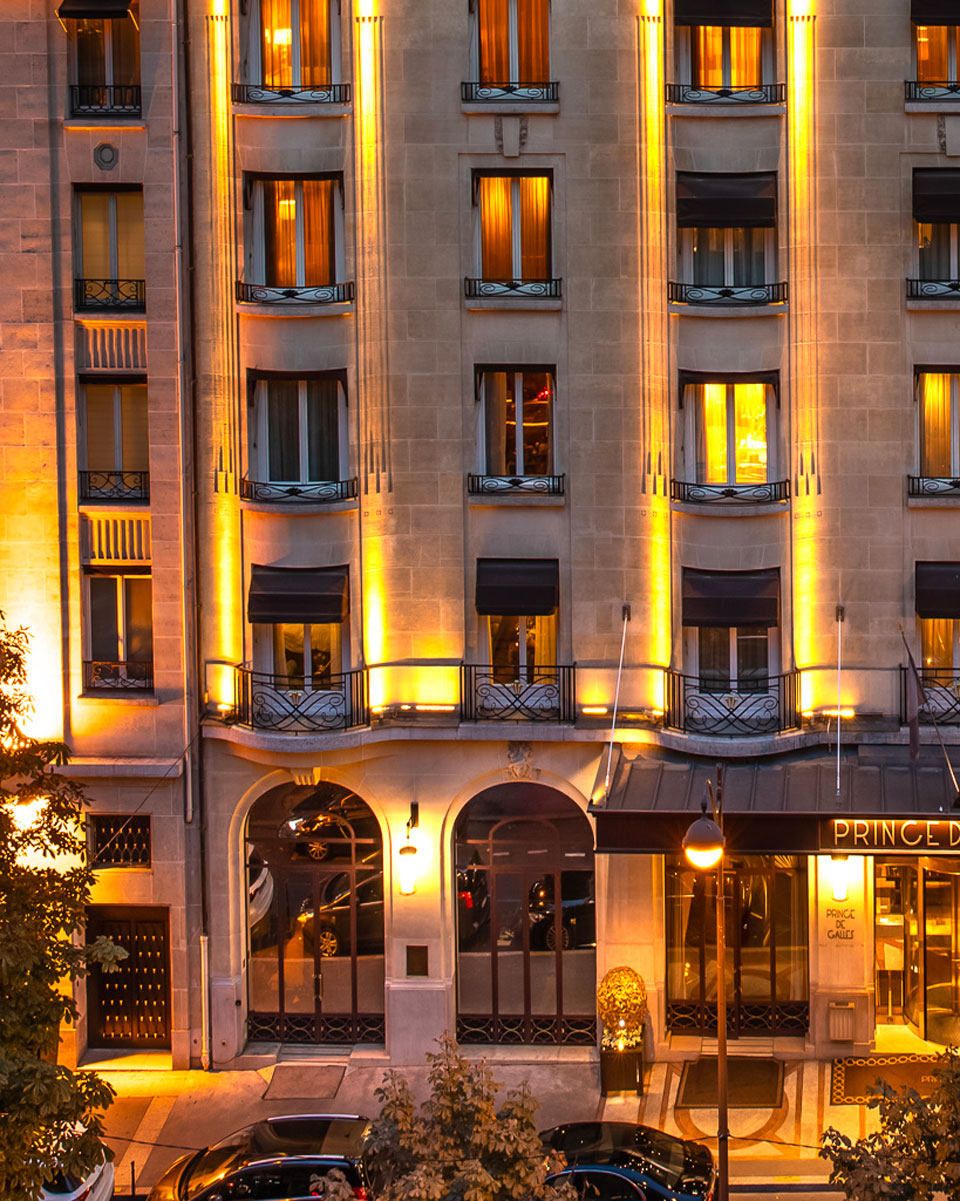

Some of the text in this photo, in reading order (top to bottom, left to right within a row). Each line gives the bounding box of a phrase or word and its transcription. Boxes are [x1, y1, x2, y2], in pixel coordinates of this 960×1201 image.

[834, 820, 940, 846] PRINCE
[826, 909, 855, 919] PRINCE
[836, 920, 845, 929] DE
[827, 930, 854, 939] GALLES
